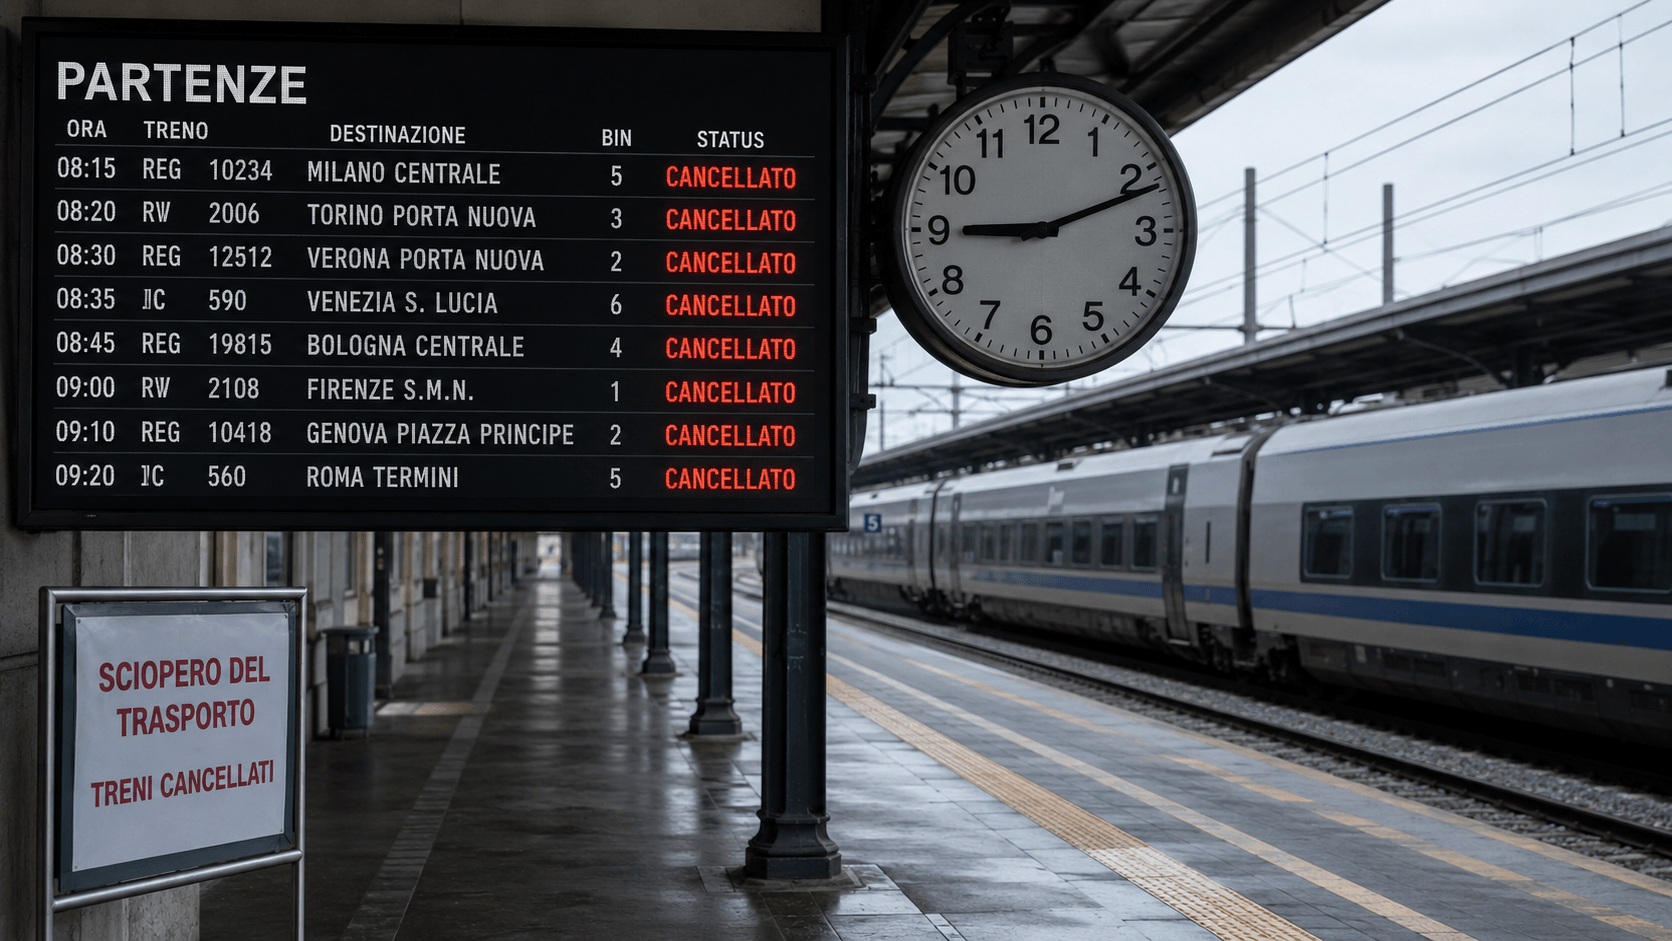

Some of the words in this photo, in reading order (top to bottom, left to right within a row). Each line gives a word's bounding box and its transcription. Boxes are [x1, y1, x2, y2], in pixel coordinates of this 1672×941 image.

[57, 61, 307, 105] PARTENZE
[66, 118, 108, 138] ORA
[143, 120, 209, 140] TRENO
[330, 124, 466, 145] DESTINAZIONE
[602, 128, 632, 147] BIN
[696, 130, 765, 149] STATUS
[976, 128, 1004, 159] 11
[1023, 113, 1060, 145] 12
[1087, 127, 1099, 157] 1
[57, 156, 116, 179] 08:15
[142, 157, 181, 180] REG
[209, 158, 273, 182] 10234
[307, 160, 385, 183] MILANO
[394, 161, 501, 185] CENTRALE
[610, 164, 623, 187] 5
[666, 166, 796, 189] CANCELLATO
[939, 164, 976, 196] 10
[1119, 163, 1142, 195] 2
[56, 199, 116, 222] 08:20
[209, 201, 260, 224] 2006
[306, 203, 384, 226] TORINO
[393, 204, 459, 227] PORTA
[468, 205, 537, 228] NUOVA
[610, 207, 623, 229] 3
[666, 208, 796, 231] CANCELLATO
[927, 215, 950, 246] 9
[1134, 215, 1157, 247] 3
[56, 243, 116, 266] 08:30
[142, 244, 181, 267] REG
[209, 245, 272, 268] 12512
[306, 246, 391, 270] VERONA
[400, 247, 466, 270] PORTA
[475, 248, 545, 271] NUOVA
[610, 250, 622, 272] 2
[666, 251, 796, 274] CANCELLATO
[941, 264, 964, 295] 8
[1118, 266, 1142, 296] 4
[56, 286, 116, 310] 08:35
[208, 289, 247, 311] 590
[306, 290, 396, 313] VENEZIA
[404, 291, 425, 313] S.
[435, 291, 498, 314] LUCIA
[610, 293, 623, 315] 6
[666, 294, 796, 317] CANCELLATO
[979, 300, 1001, 330] 7
[1082, 301, 1104, 331] 5
[56, 330, 116, 354] 08:45
[142, 332, 181, 355] REG
[209, 332, 272, 355] 19815
[307, 333, 407, 357] BOLOGNA
[415, 334, 525, 358] CENTRALE
[609, 336, 623, 358] 4
[666, 337, 796, 360] CANCELLATO
[1030, 315, 1053, 345] 6
[56, 375, 115, 398] 09:00
[208, 376, 260, 400] 2108
[307, 377, 395, 401] FIRENZE
[403, 378, 474, 401] S.M.N.
[610, 380, 619, 402] 1
[666, 381, 795, 404] CANCELLATO
[55, 419, 115, 443] 09:10
[141, 420, 180, 443] REG
[208, 421, 272, 444] 10418
[306, 421, 388, 444] GENOVA
[397, 422, 471, 445] PIAZZA
[480, 423, 574, 445] PRINCIPE
[610, 423, 622, 446] 2
[665, 424, 795, 447] CANCELLATO
[55, 463, 115, 487] 09:20
[208, 464, 246, 487] 560
[306, 465, 365, 488] ROMA
[372, 465, 458, 488] TERMINI
[609, 467, 622, 490] 5
[665, 467, 795, 490] CANCELLATO
[98, 657, 222, 693] SCIOPERO
[229, 655, 271, 684] DEL
[116, 698, 255, 737] TRASPORTO
[90, 775, 153, 808] TRENI
[160, 759, 274, 798] CANCELLATI
